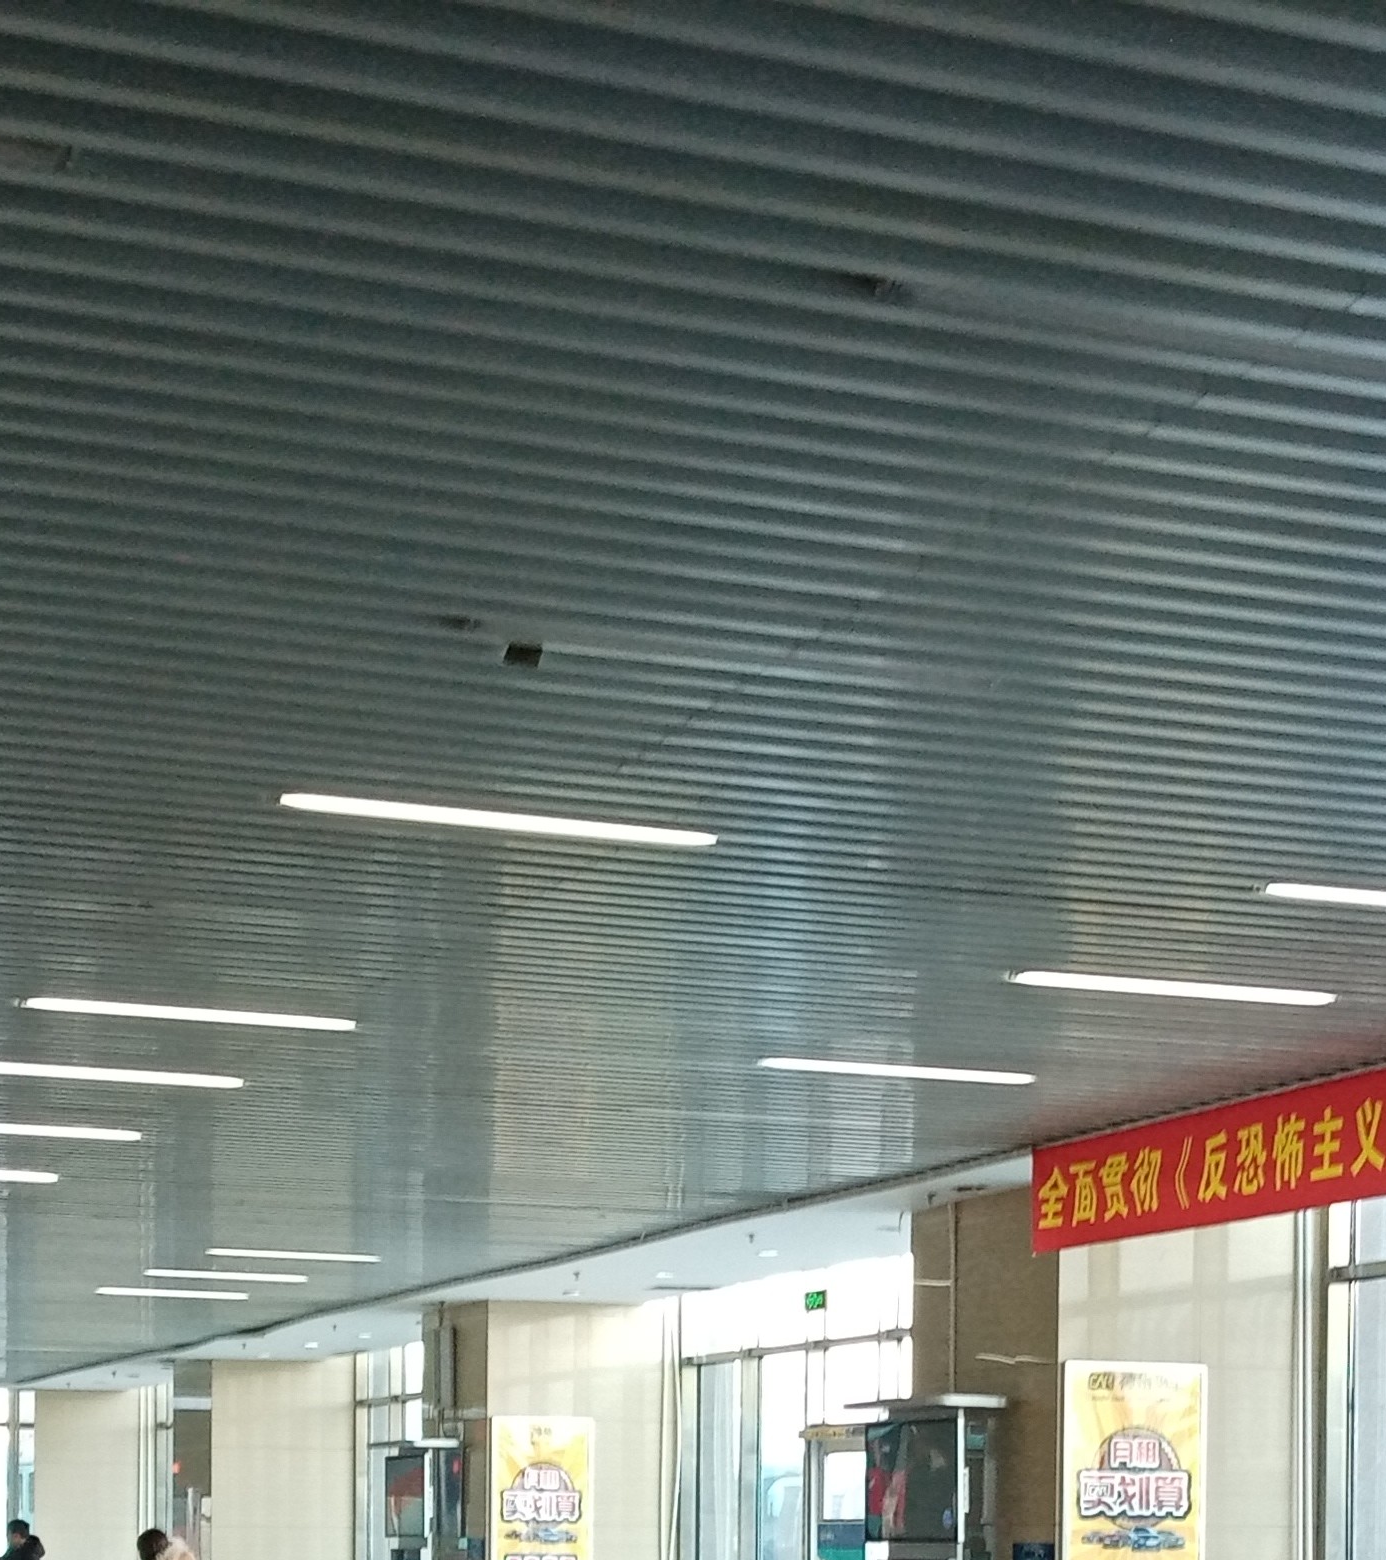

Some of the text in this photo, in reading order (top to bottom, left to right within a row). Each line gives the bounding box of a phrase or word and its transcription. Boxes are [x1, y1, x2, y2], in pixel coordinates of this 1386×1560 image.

[1111, 1438, 1160, 1468] 月租
[1081, 1473, 1189, 1517] 更划算
